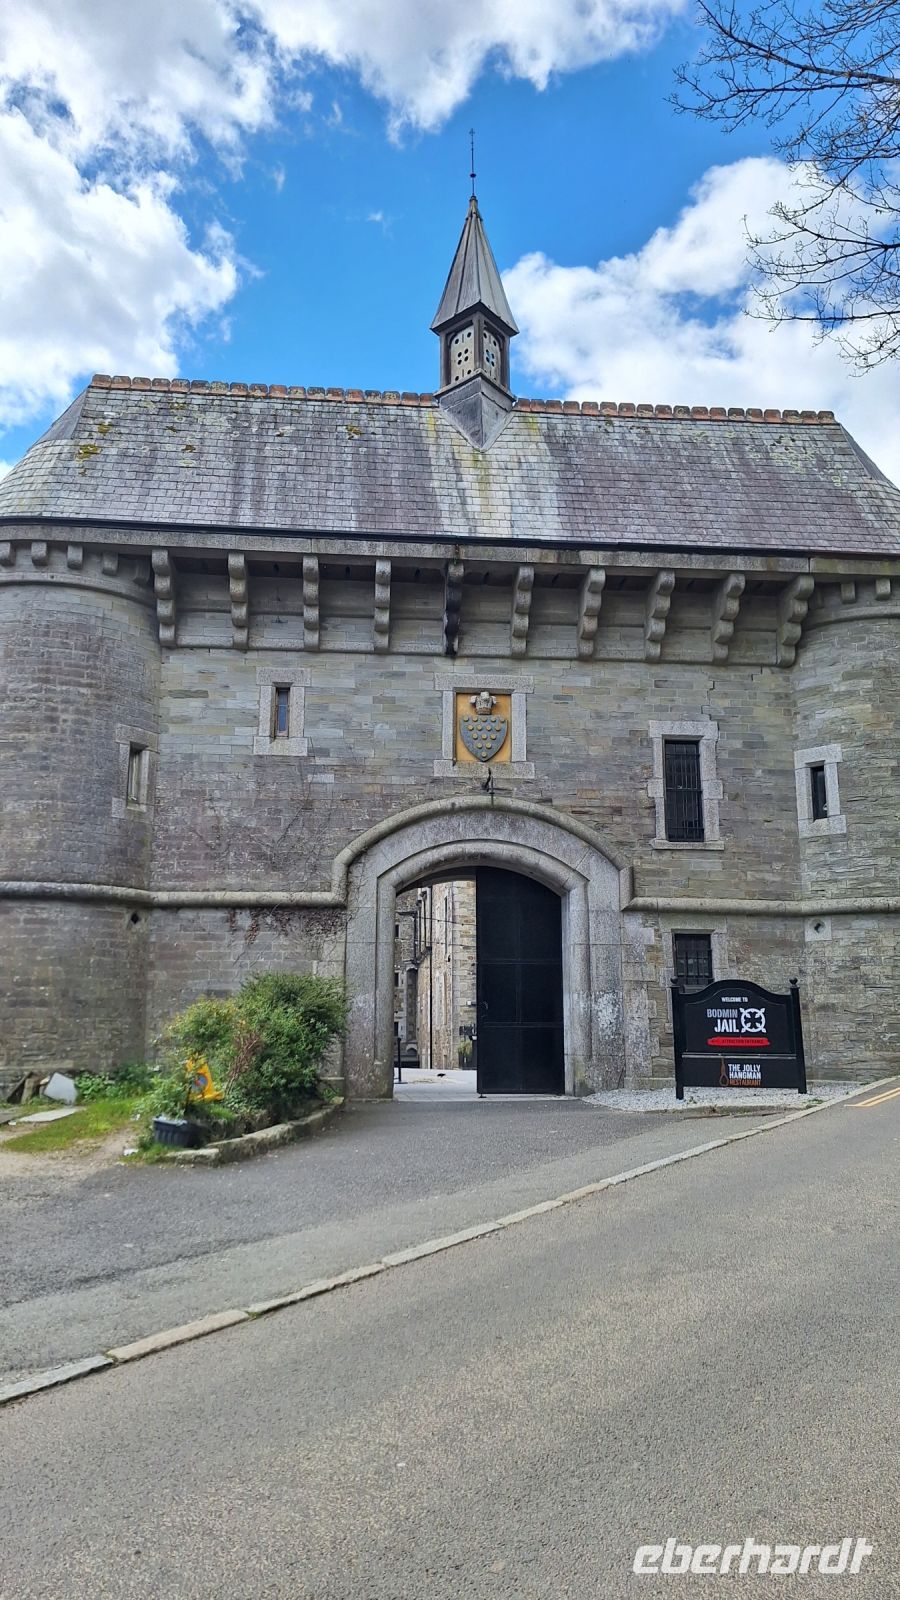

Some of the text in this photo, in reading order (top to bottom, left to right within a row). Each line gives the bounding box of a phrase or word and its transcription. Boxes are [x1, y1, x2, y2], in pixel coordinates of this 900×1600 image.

[706, 1008, 738, 1018] BODMIN
[714, 1019, 740, 1032] JAIL
[728, 1064, 761, 1072] THE JOLLY
